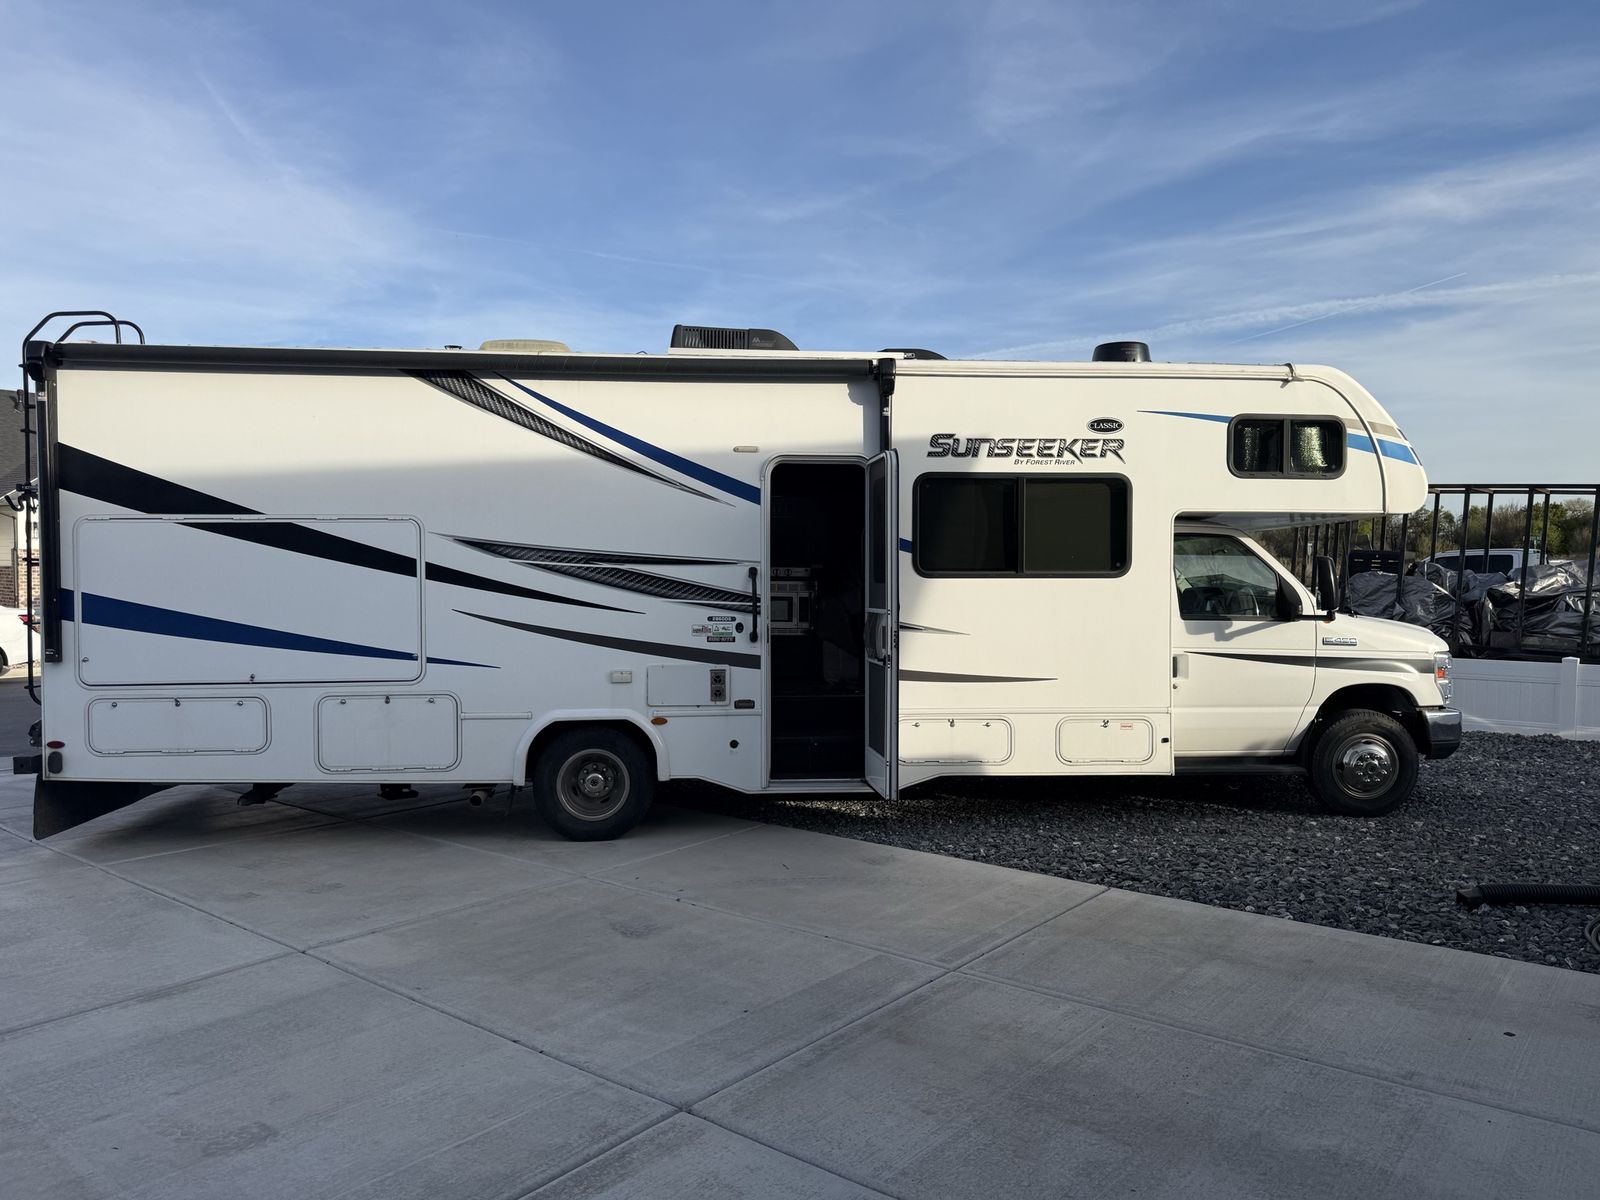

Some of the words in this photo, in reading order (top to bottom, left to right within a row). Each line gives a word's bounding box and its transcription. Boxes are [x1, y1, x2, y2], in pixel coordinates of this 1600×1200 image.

[1088, 421, 1122, 429] CLASSIC
[1025, 458, 1053, 466] FOREST
[1054, 458, 1076, 466] RIVER
